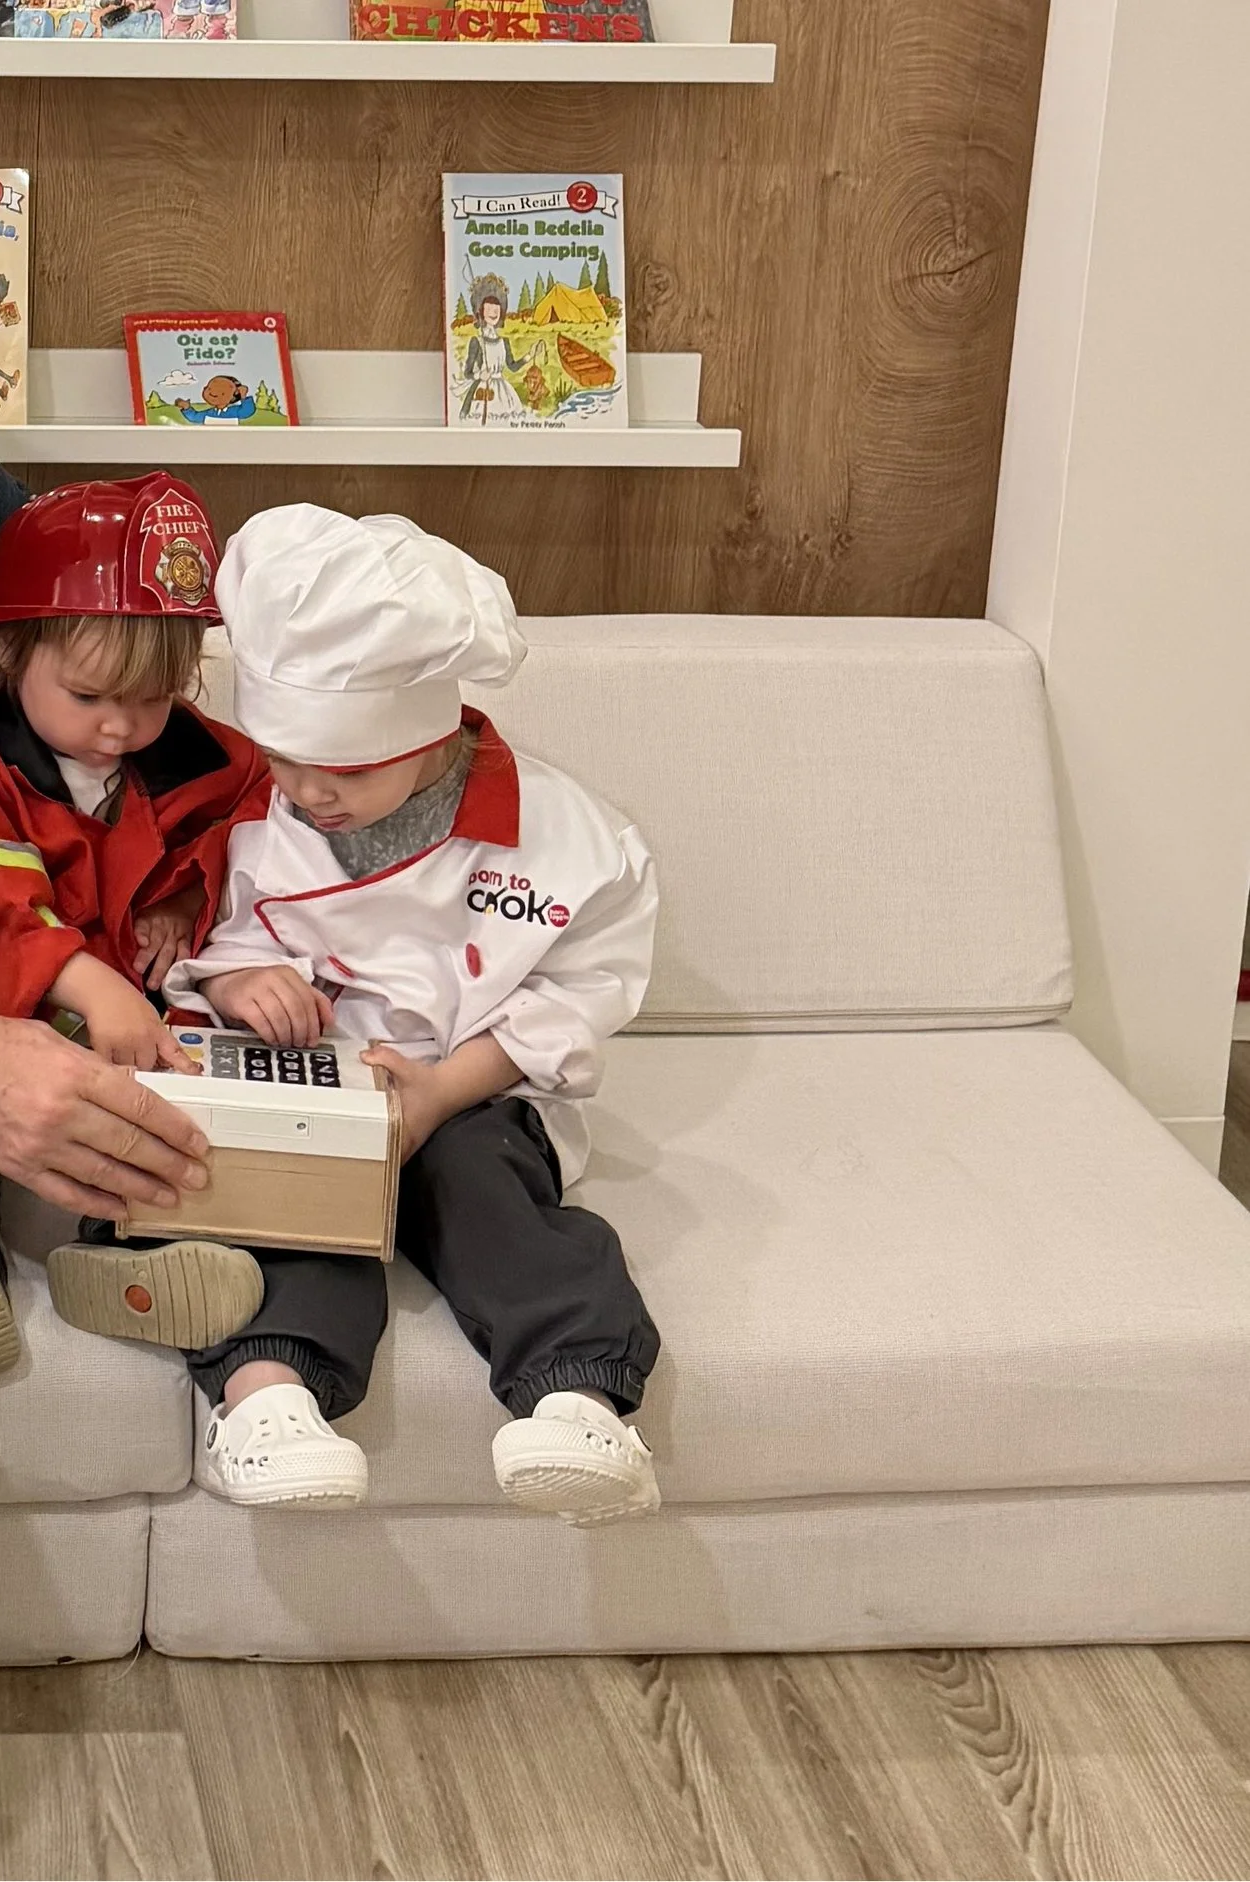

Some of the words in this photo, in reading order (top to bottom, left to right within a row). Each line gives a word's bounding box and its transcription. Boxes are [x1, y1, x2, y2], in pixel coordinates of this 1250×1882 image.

[358, 5, 643, 42] CHICKENS
[476, 200, 481, 211] I
[486, 200, 516, 212] Can
[520, 194, 561, 210] Read!
[577, 188, 587, 203] 2
[465, 219, 529, 236] Amelia
[534, 219, 604, 236] Bedelia
[468, 241, 514, 257] Goes
[519, 241, 600, 261] Camping
[177, 333, 203, 346] Où
[209, 333, 239, 346] est
[184, 348, 236, 360] Fido?
[155, 504, 193, 518] FIRE
[152, 521, 201, 536] CHIEF
[509, 873, 531, 890] to
